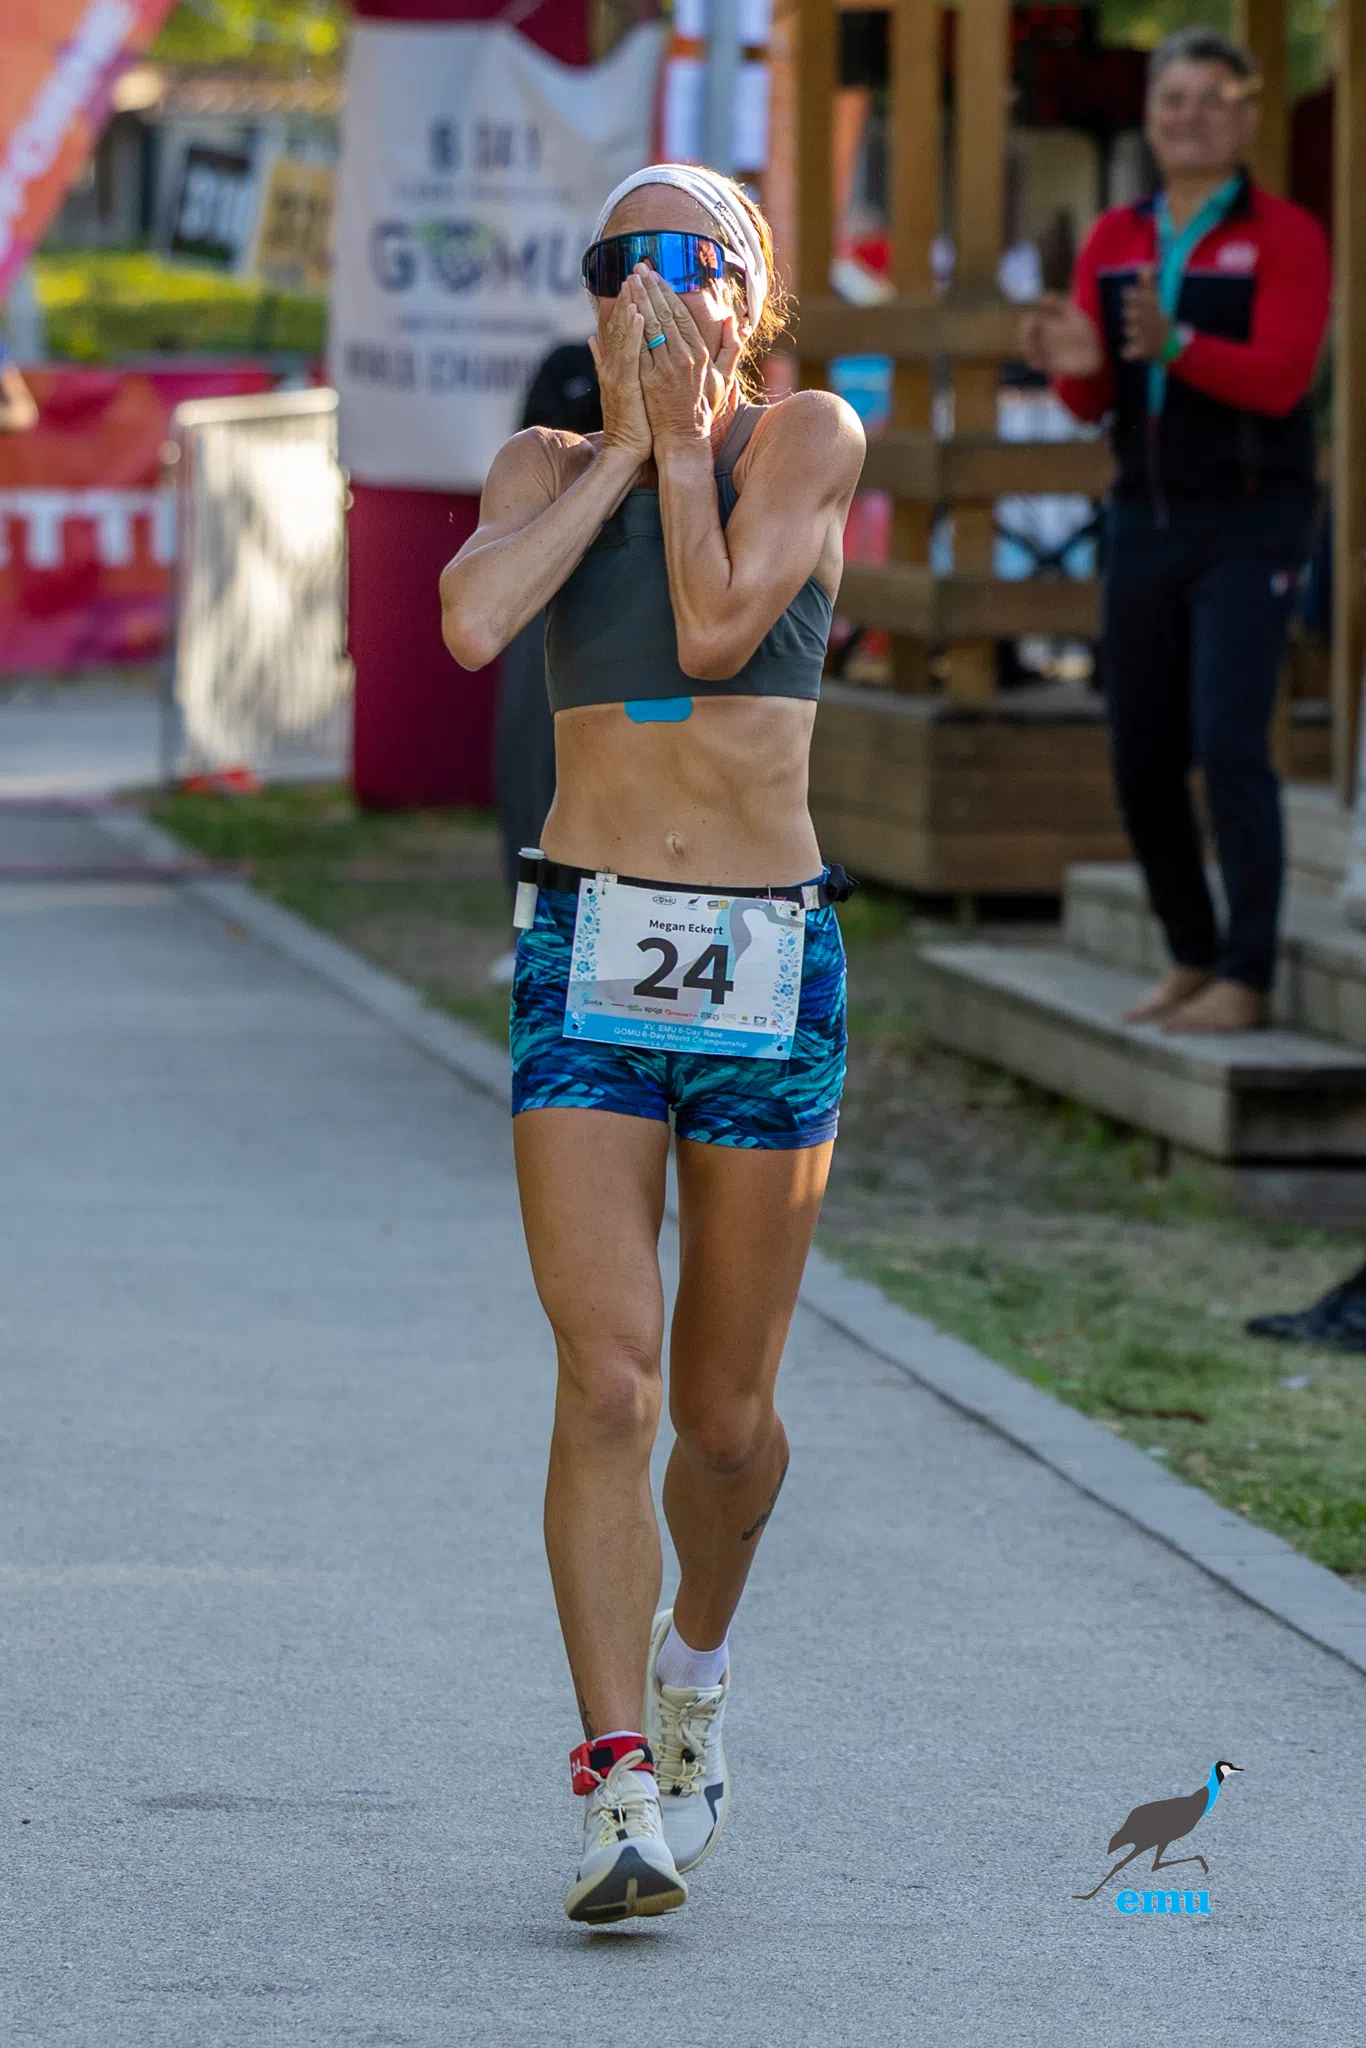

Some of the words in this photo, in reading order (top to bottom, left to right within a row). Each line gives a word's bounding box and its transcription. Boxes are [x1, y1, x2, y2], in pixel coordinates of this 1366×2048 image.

[649, 919, 685, 932] Megan
[688, 923, 724, 935] Eckert
[633, 937, 734, 1005] 24
[613, 1027, 641, 1037] GOMU
[641, 1030, 666, 1041] 6-Day
[666, 1033, 690, 1042] World
[692, 1036, 748, 1049] Championship
[658, 1024, 677, 1034] EMU
[678, 1027, 701, 1037] 6-Day
[703, 1029, 723, 1039] Race
